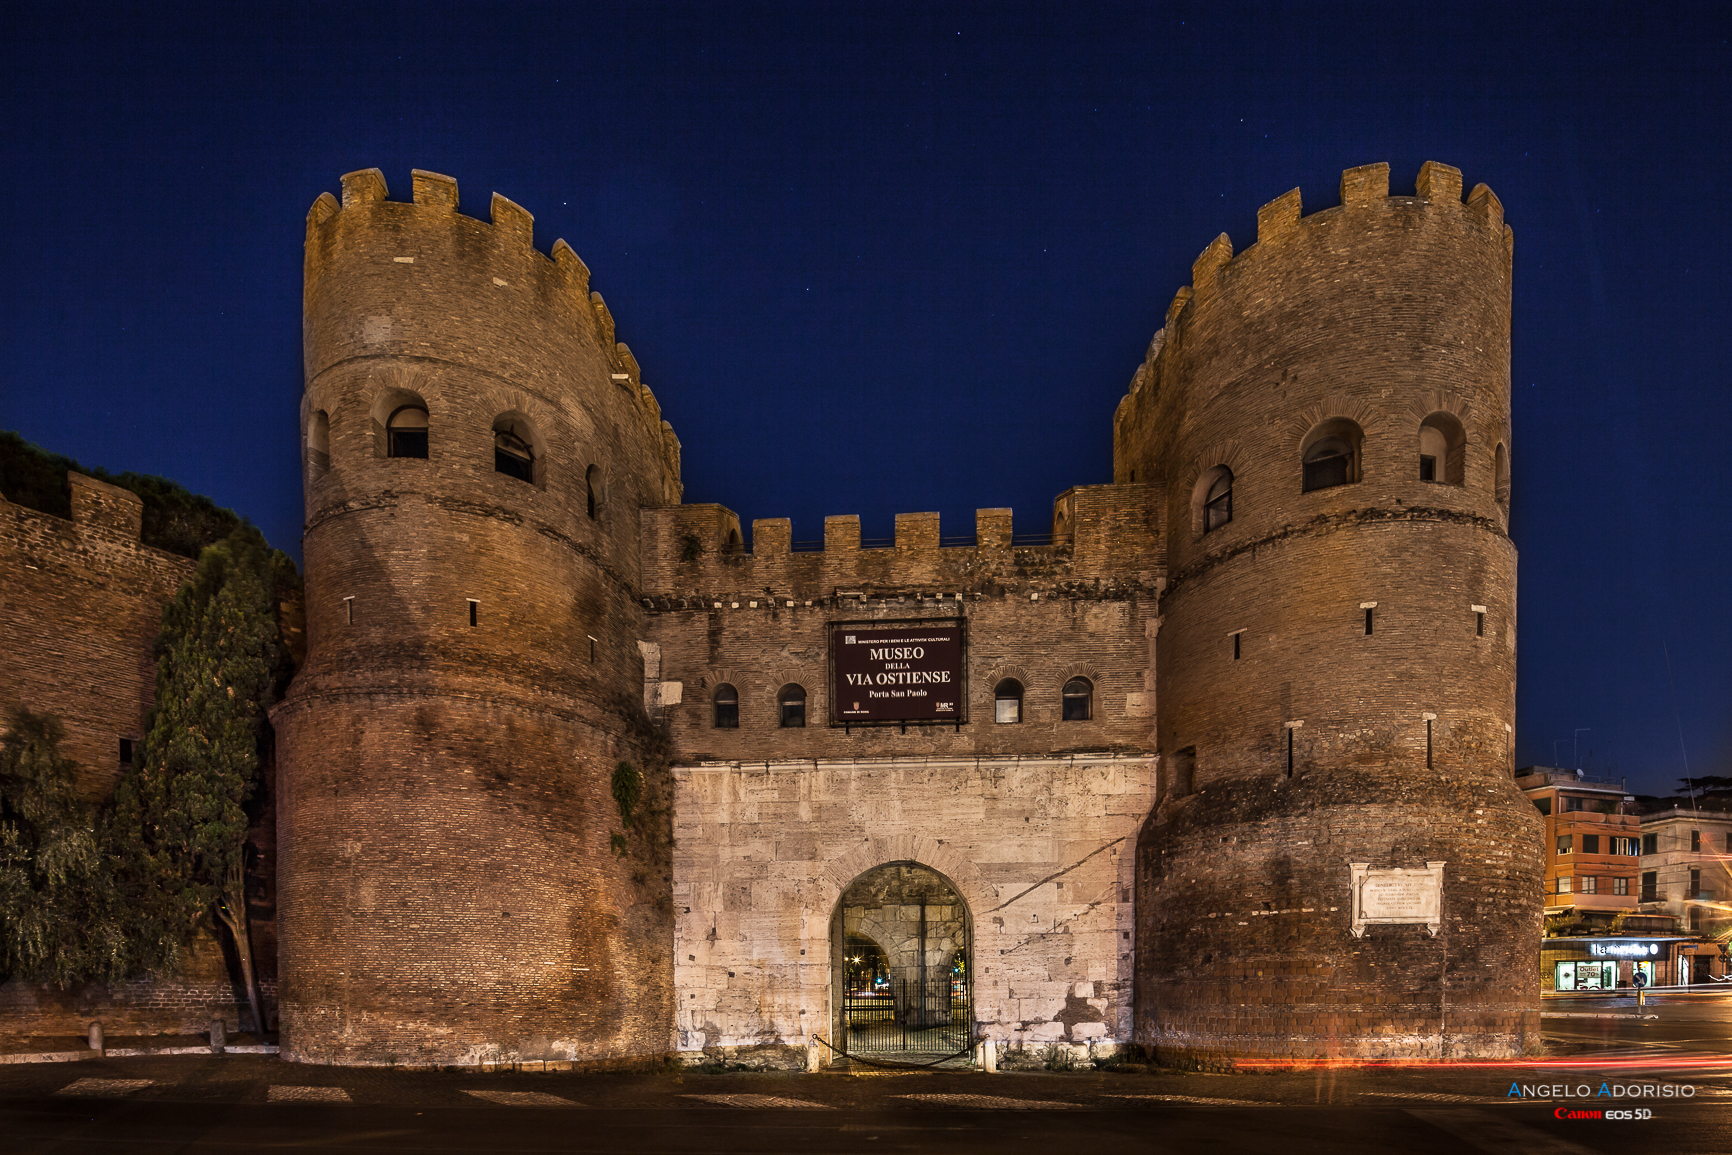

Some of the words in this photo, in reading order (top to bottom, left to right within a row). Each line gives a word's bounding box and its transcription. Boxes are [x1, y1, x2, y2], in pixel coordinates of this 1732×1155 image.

[870, 647, 924, 660] MUSEO
[846, 673, 873, 686] VIA
[876, 671, 951, 685] OSTIENSE
[869, 690, 889, 698] Porta
[907, 689, 927, 697] Paolo
